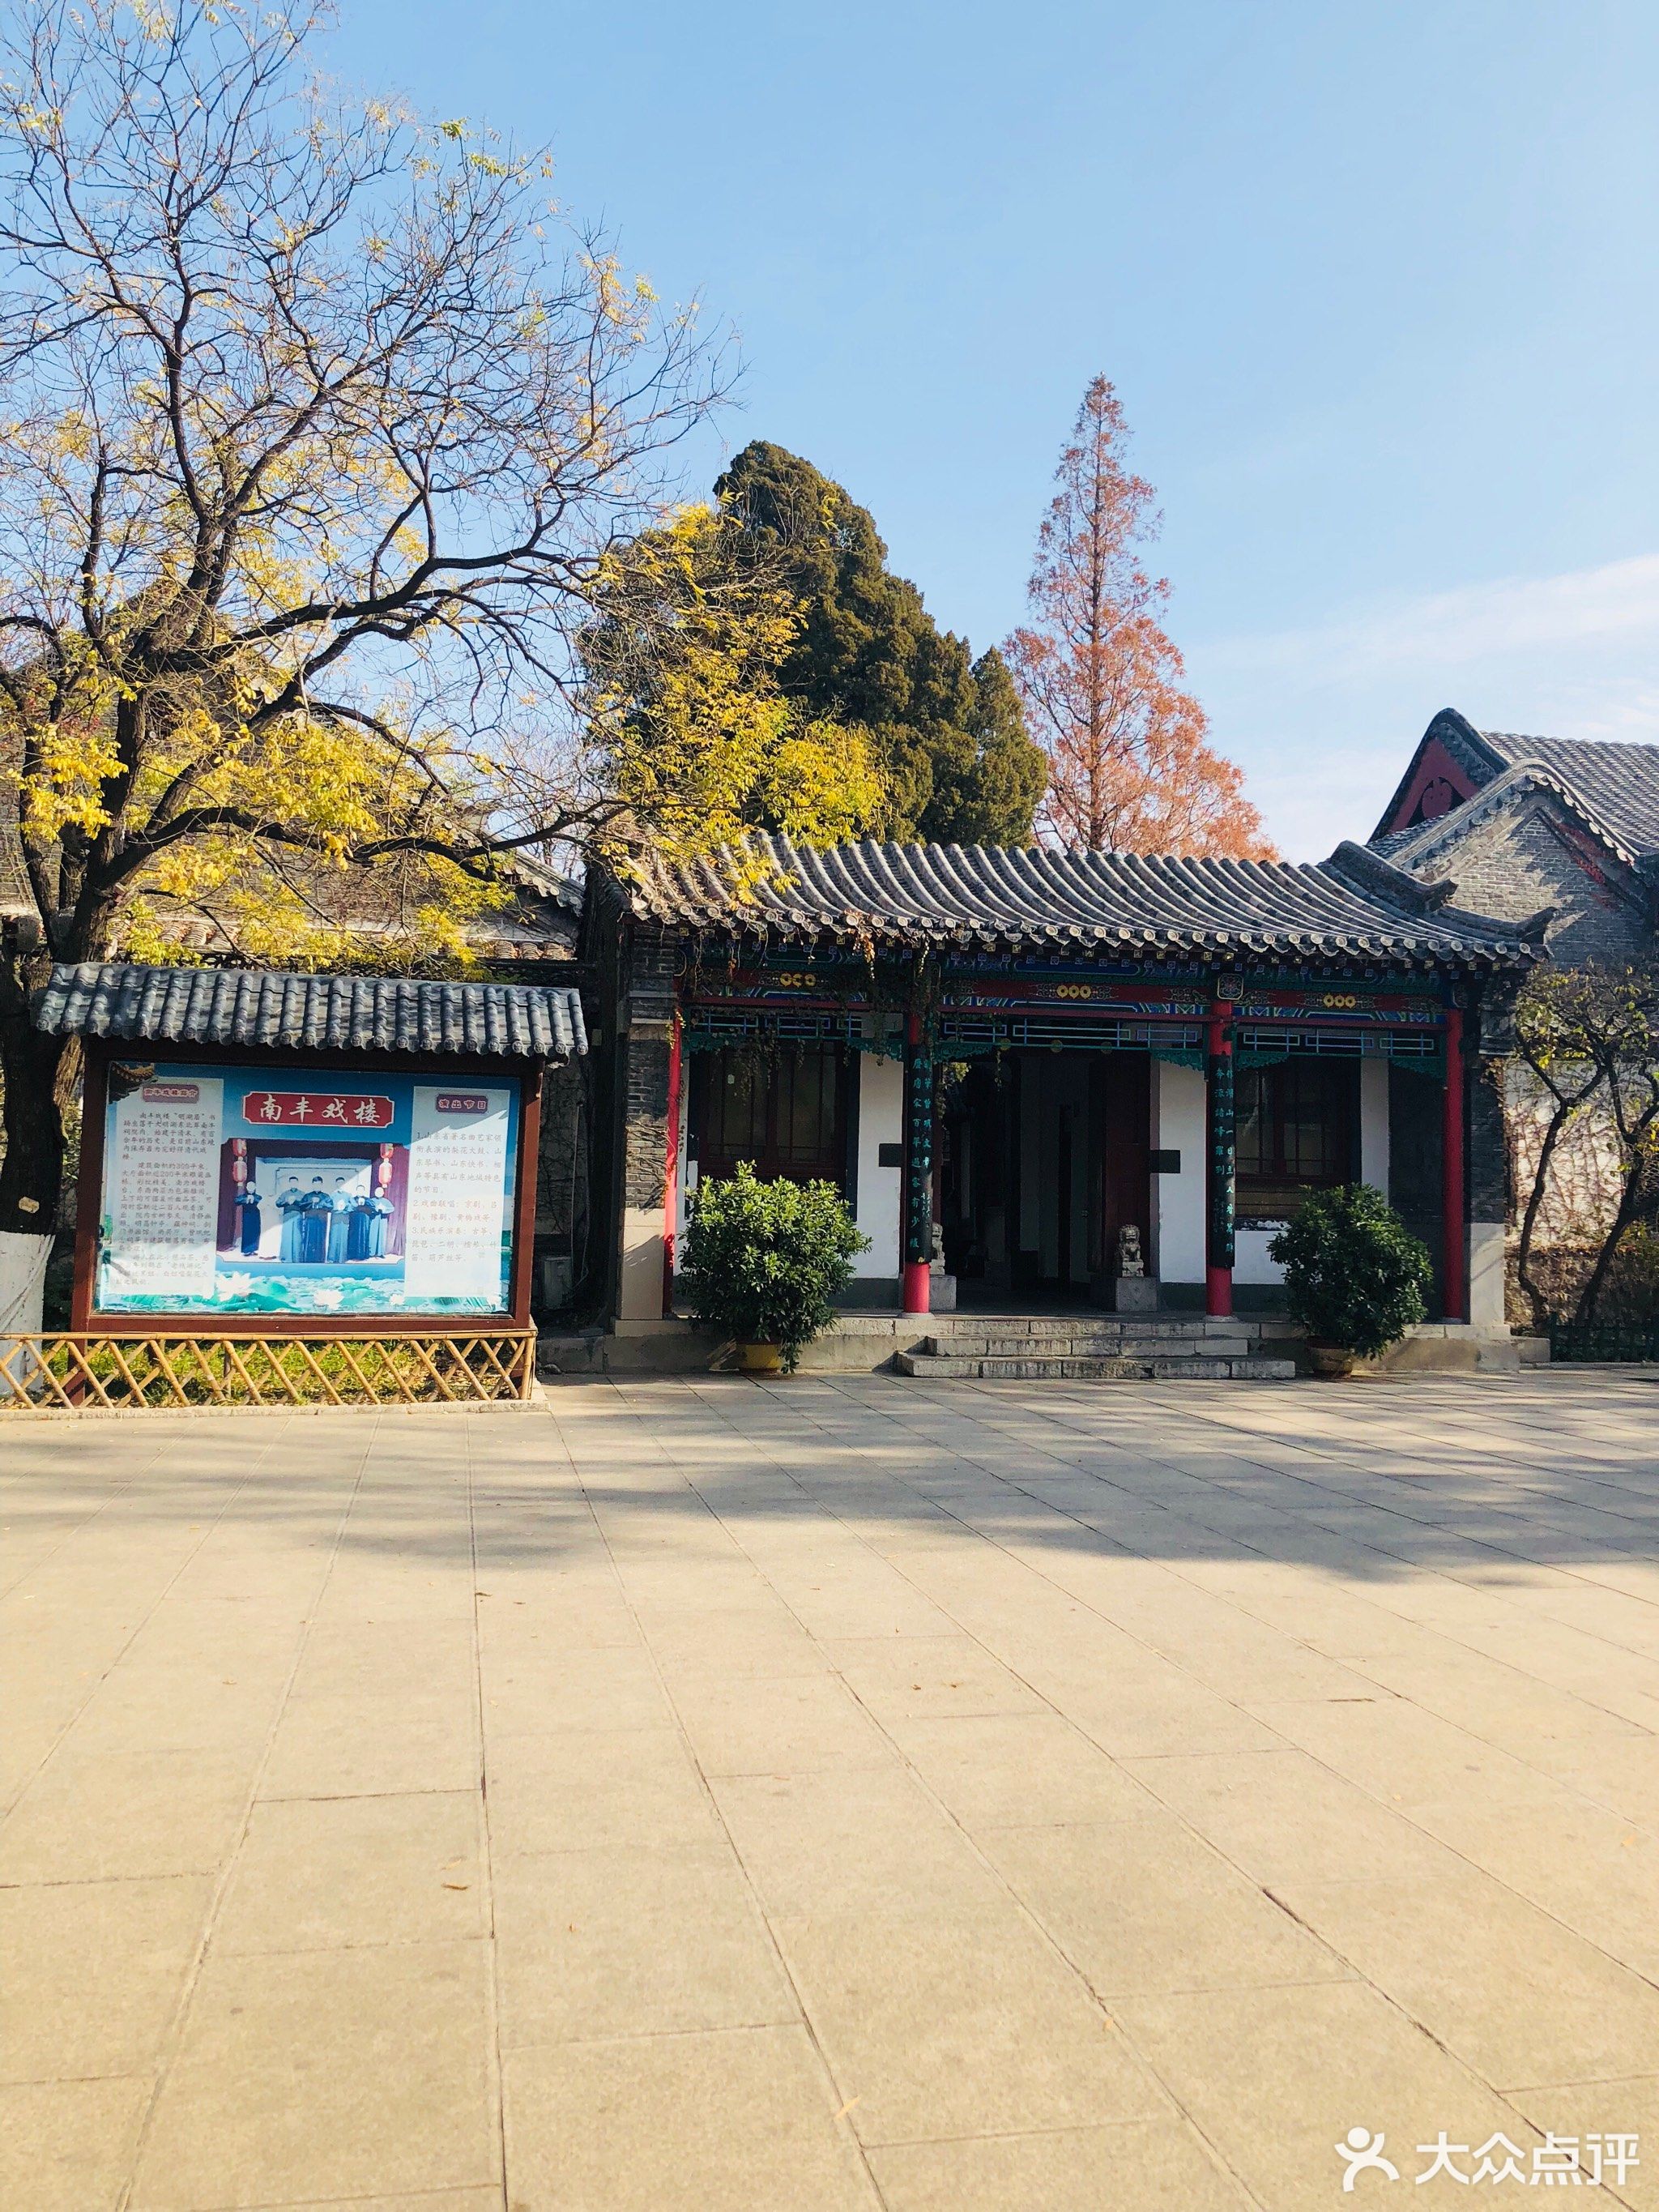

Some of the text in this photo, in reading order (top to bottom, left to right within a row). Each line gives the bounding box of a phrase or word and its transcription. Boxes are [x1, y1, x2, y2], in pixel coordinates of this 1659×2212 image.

[260, 1094, 381, 1125] 南丰戏楼
[438, 1098, 487, 1110] 演出节目
